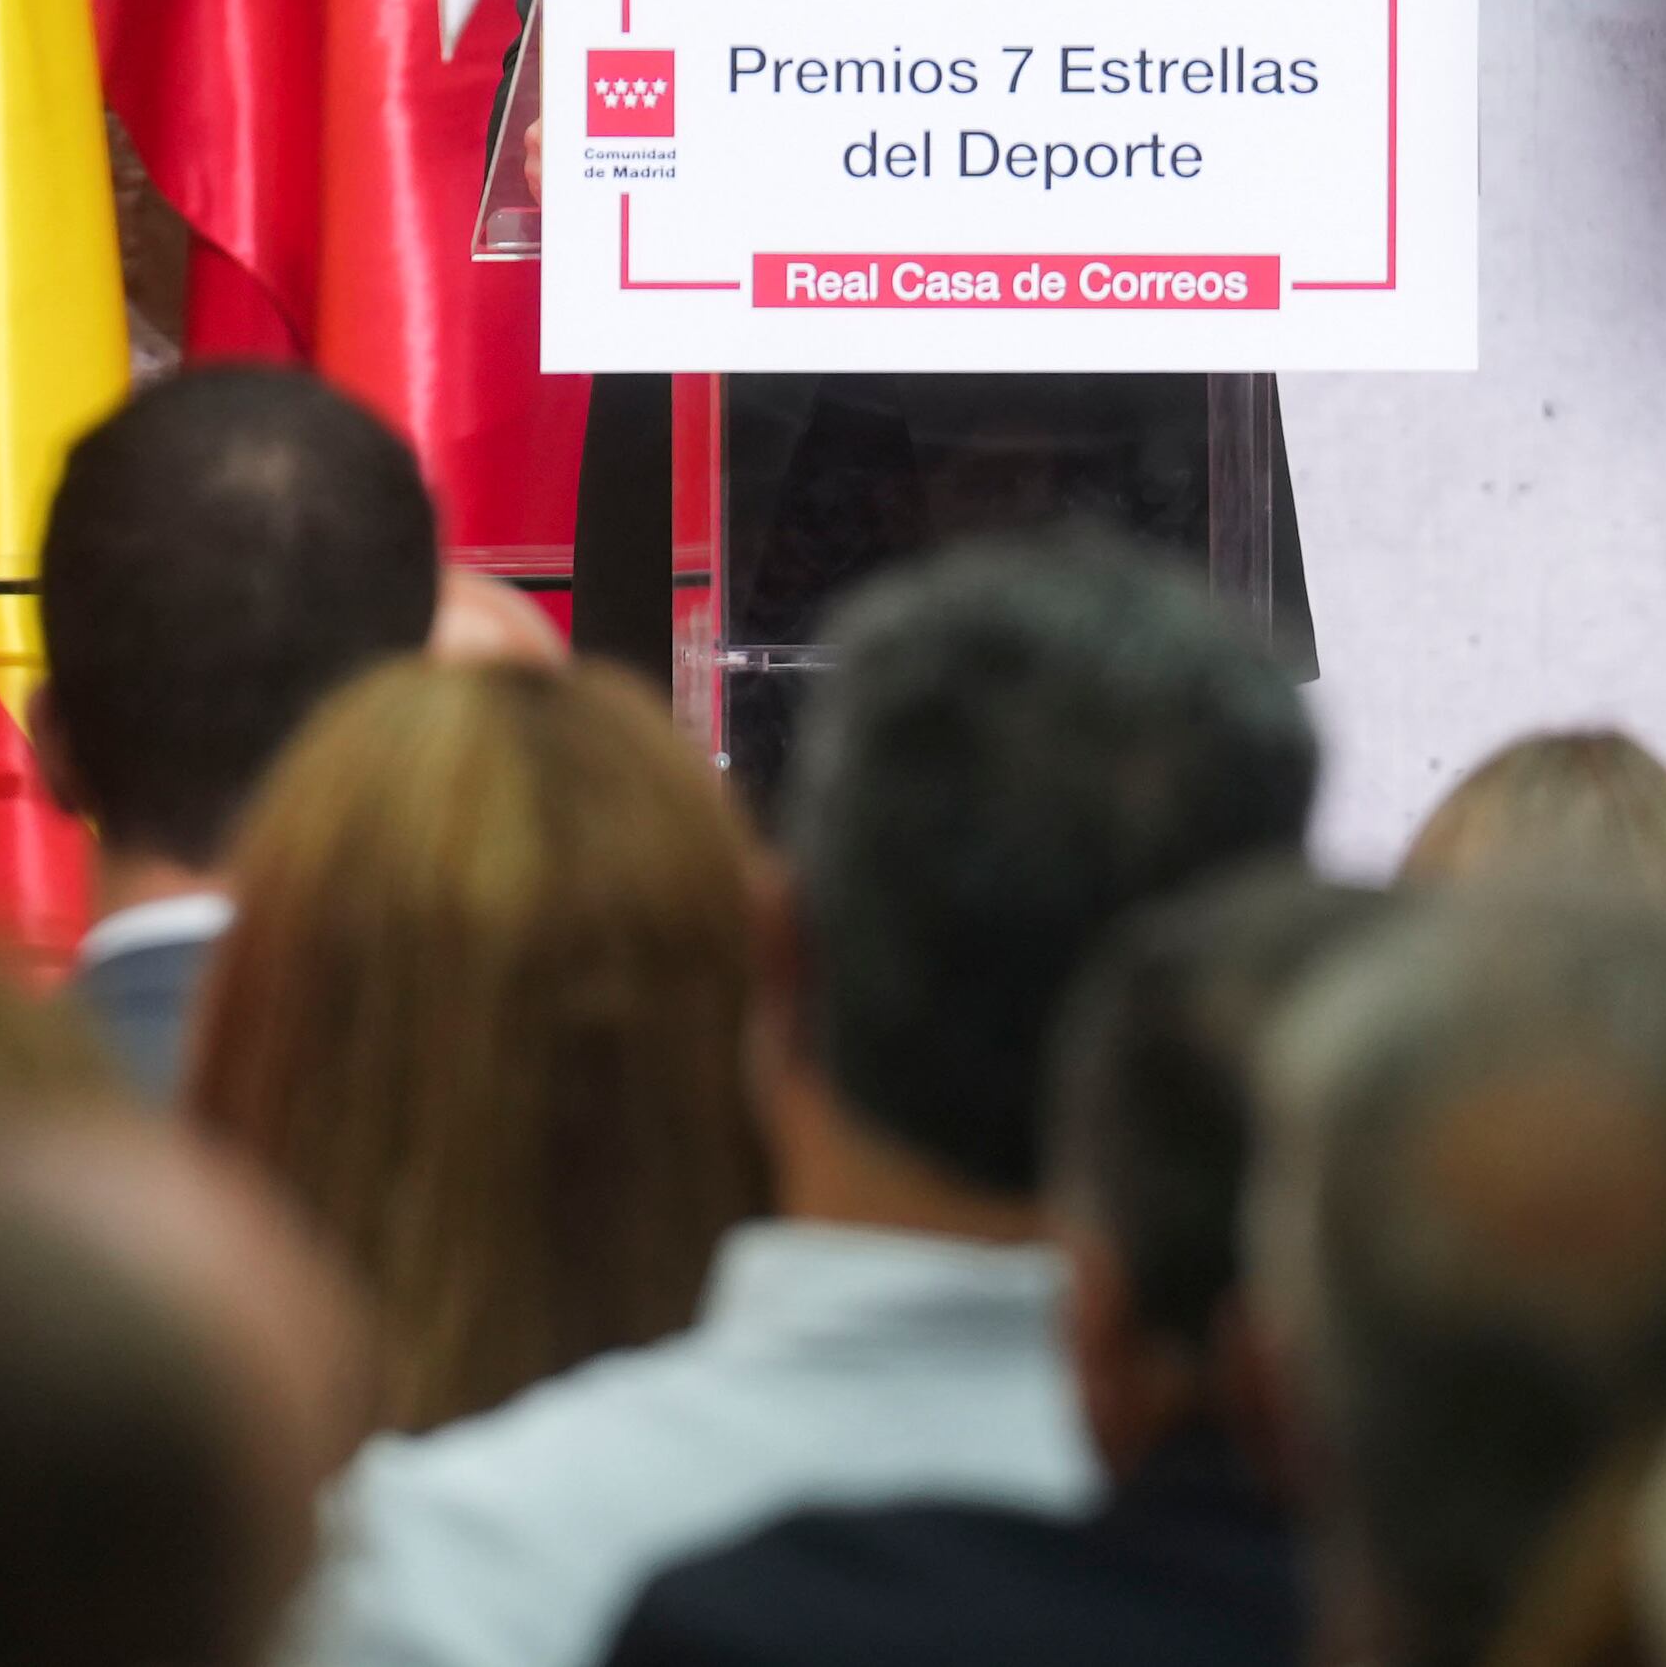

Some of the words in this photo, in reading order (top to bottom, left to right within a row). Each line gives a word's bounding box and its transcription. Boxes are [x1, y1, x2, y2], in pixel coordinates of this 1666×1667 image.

[729, 45, 979, 95] Premios
[1001, 46, 1034, 94] 7
[1060, 45, 1319, 95] Estrellas
[583, 147, 677, 161] Comunidad
[584, 165, 606, 179] de
[612, 165, 676, 179] Madrid
[843, 129, 931, 179] del
[959, 130, 1203, 191] Deporte
[786, 262, 879, 301] Real
[892, 262, 1002, 302] Casa
[1012, 262, 1067, 302] de
[1079, 262, 1248, 302] Correos
